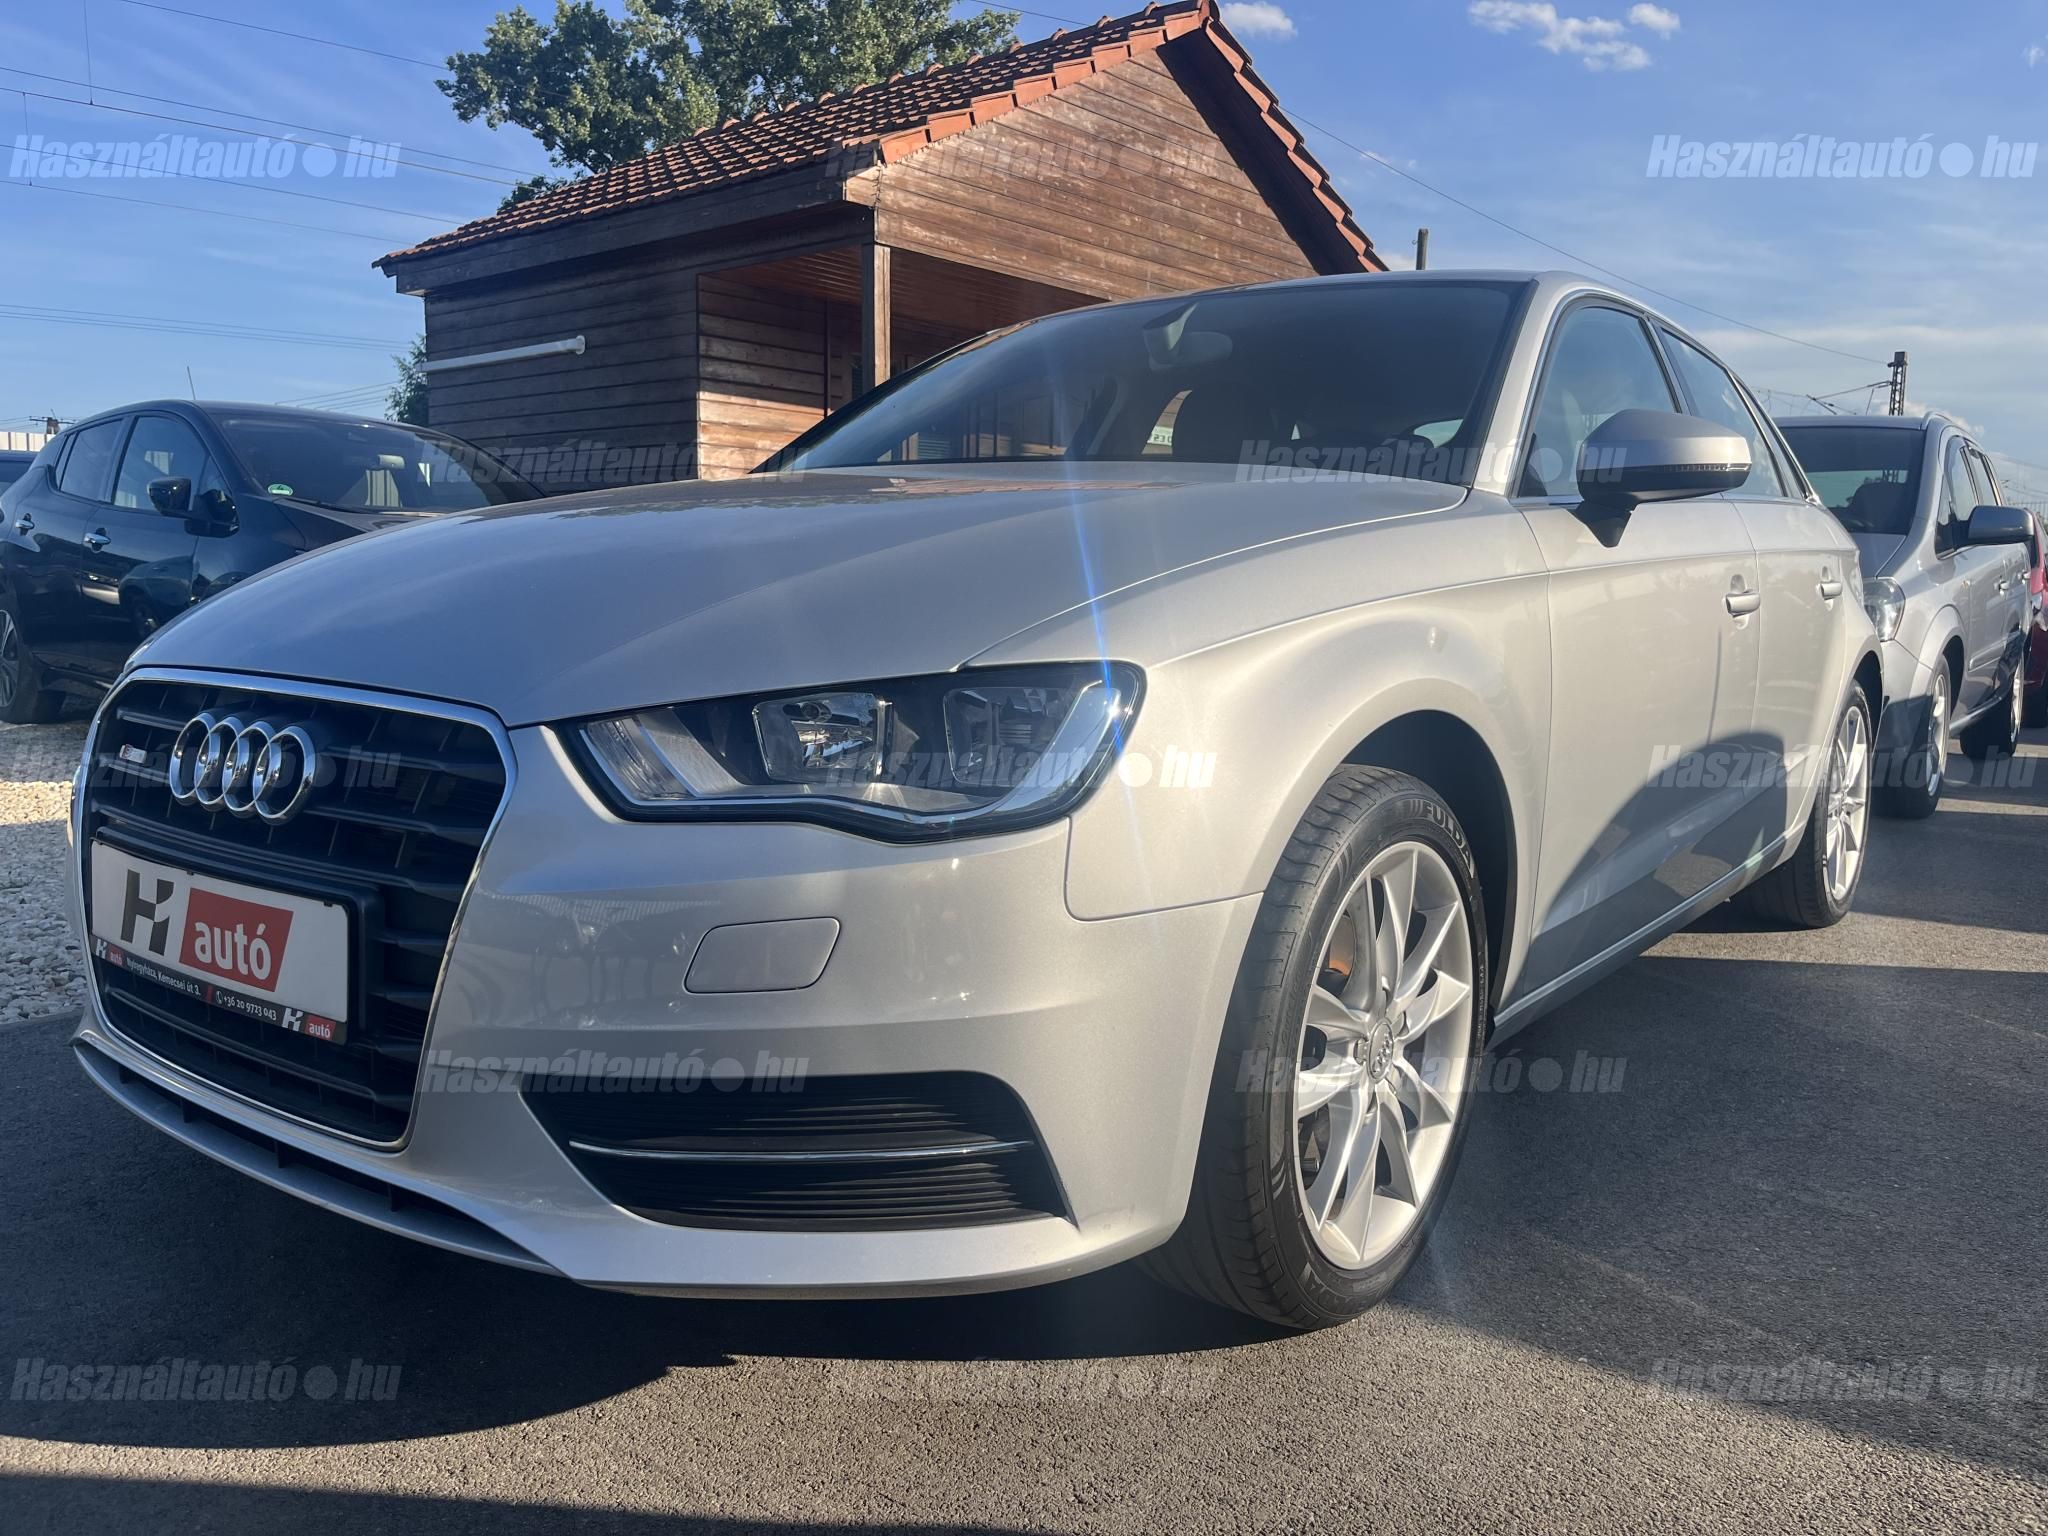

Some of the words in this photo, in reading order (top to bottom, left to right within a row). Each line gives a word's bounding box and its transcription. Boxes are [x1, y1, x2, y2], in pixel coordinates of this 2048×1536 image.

[1423, 799, 1476, 878] FULDA
[194, 920, 272, 981] autó
[223, 996, 236, 1008] +36
[236, 1000, 245, 1010] 20
[246, 1002, 263, 1017] 9723
[263, 1007, 277, 1021] 043
[309, 1022, 331, 1039] autó
